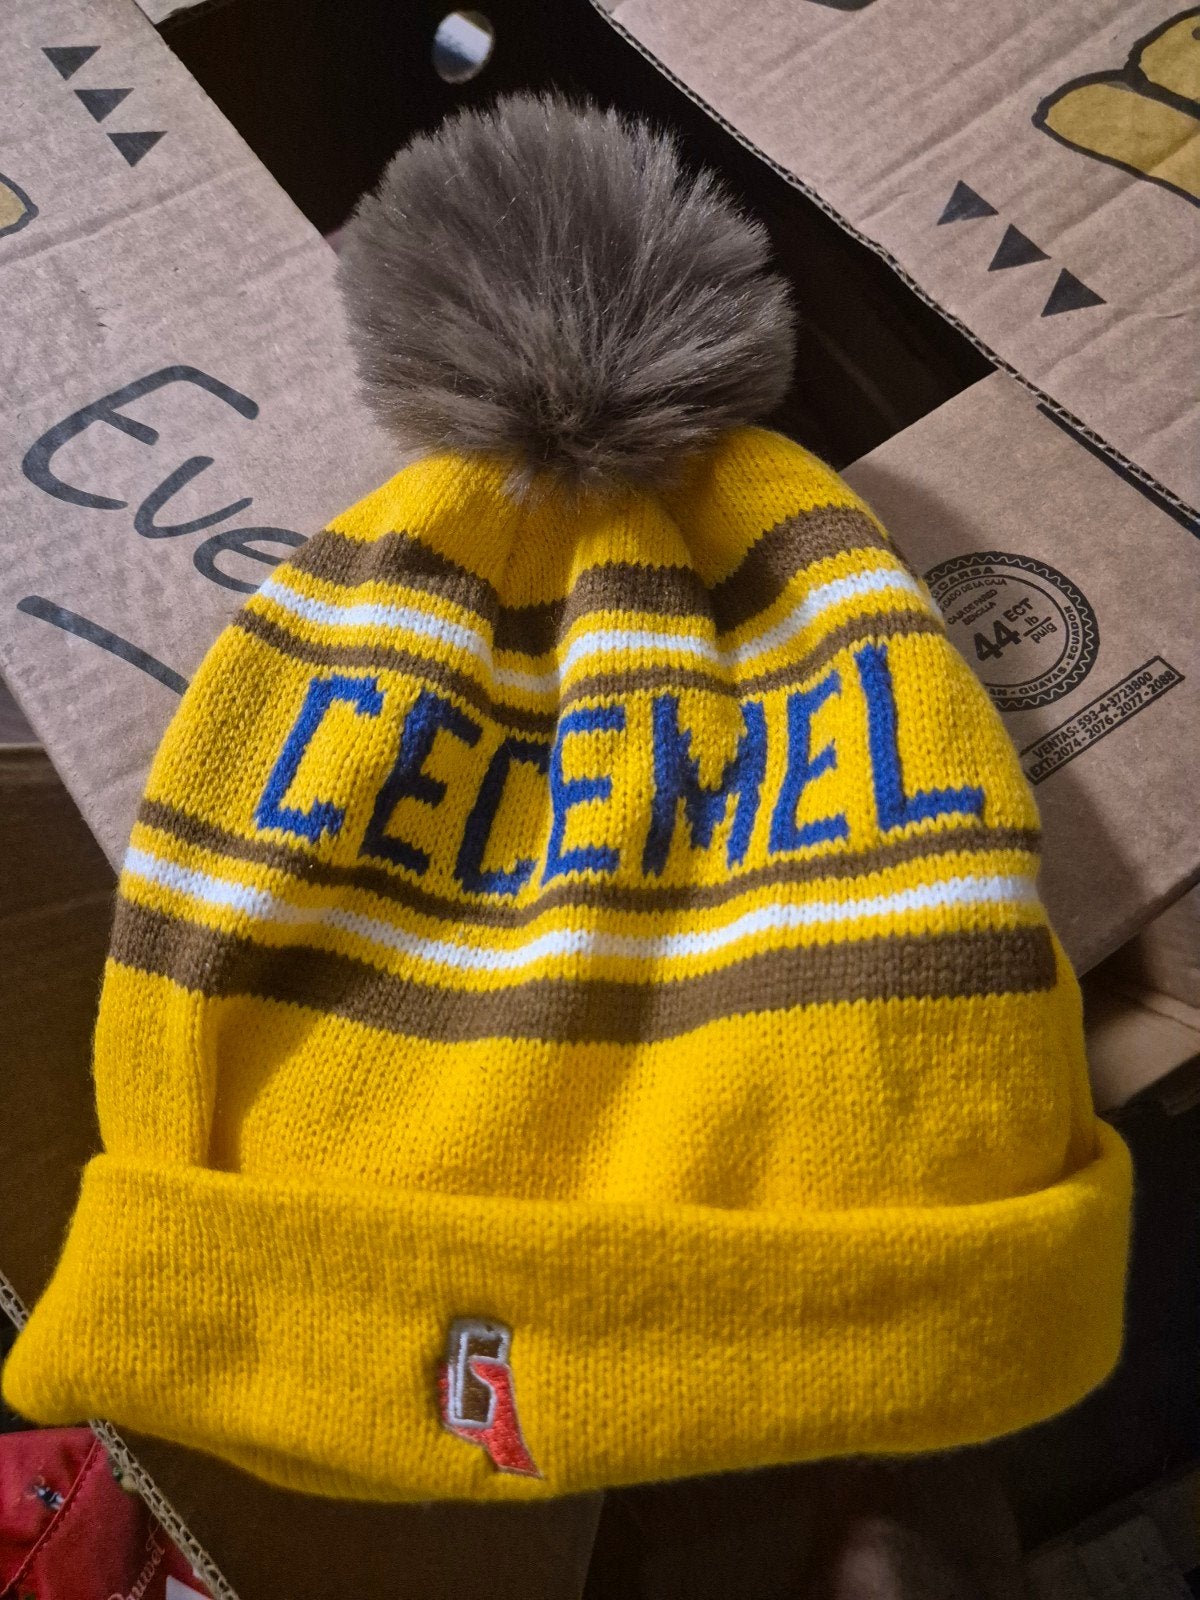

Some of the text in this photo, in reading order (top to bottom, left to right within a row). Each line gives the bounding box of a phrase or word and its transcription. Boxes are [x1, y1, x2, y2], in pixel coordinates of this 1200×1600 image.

[1002, 597, 1033, 623] ECT
[1024, 615, 1039, 627] lb
[973, 620, 1022, 661] 44
[1018, 666, 1068, 695] GUAYAS
[1063, 606, 1081, 660] ECUADOR
[1030, 622, 1058, 644] pulg
[1032, 725, 1080, 759] VENTAS:
[1052, 738, 1083, 761] 2074
[1084, 714, 1114, 740] 2076
[1116, 692, 1143, 717] 2077
[254, 643, 985, 896] CECEMEL
